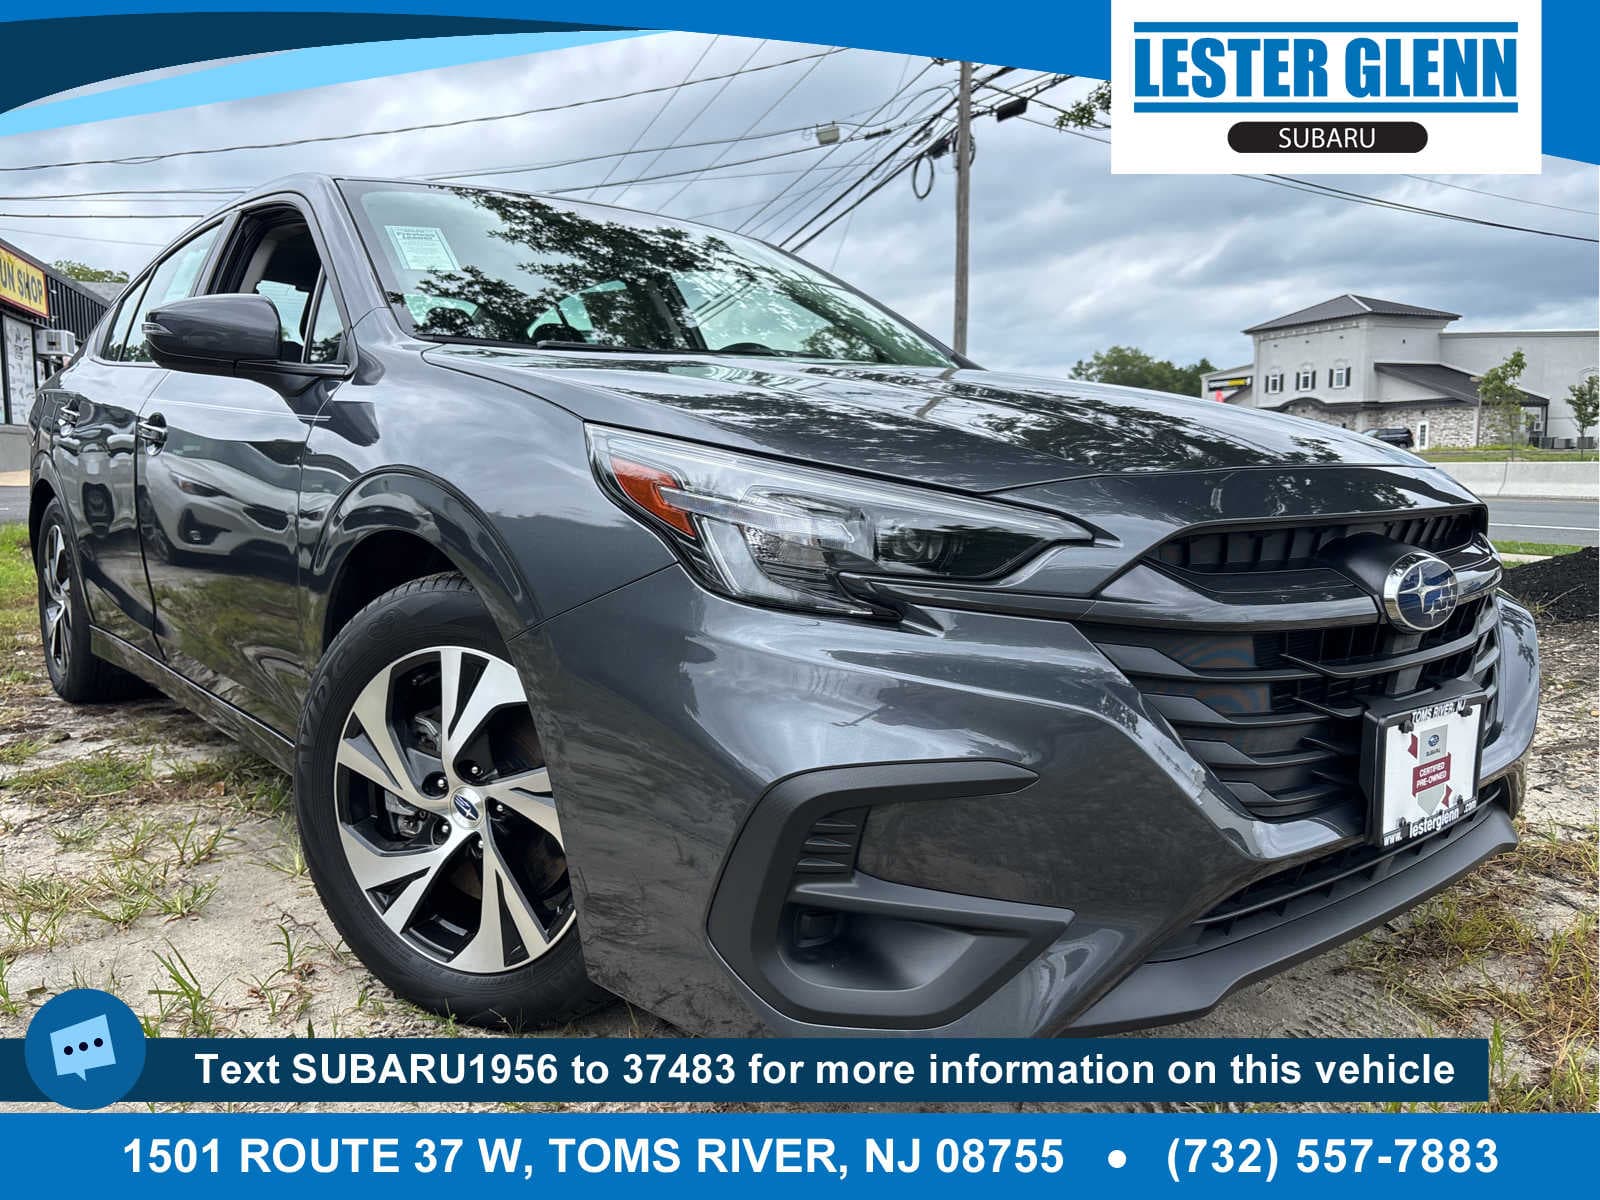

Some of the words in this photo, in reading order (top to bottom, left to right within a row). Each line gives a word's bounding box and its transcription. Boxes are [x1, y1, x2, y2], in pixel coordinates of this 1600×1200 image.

[17, 268, 43, 305] SHOP
[1412, 708, 1432, 723] TOMS
[1457, 698, 1466, 711] NJ
[1416, 770, 1447, 788] PRE-OWNED
[1419, 761, 1445, 778] CERTIFIED
